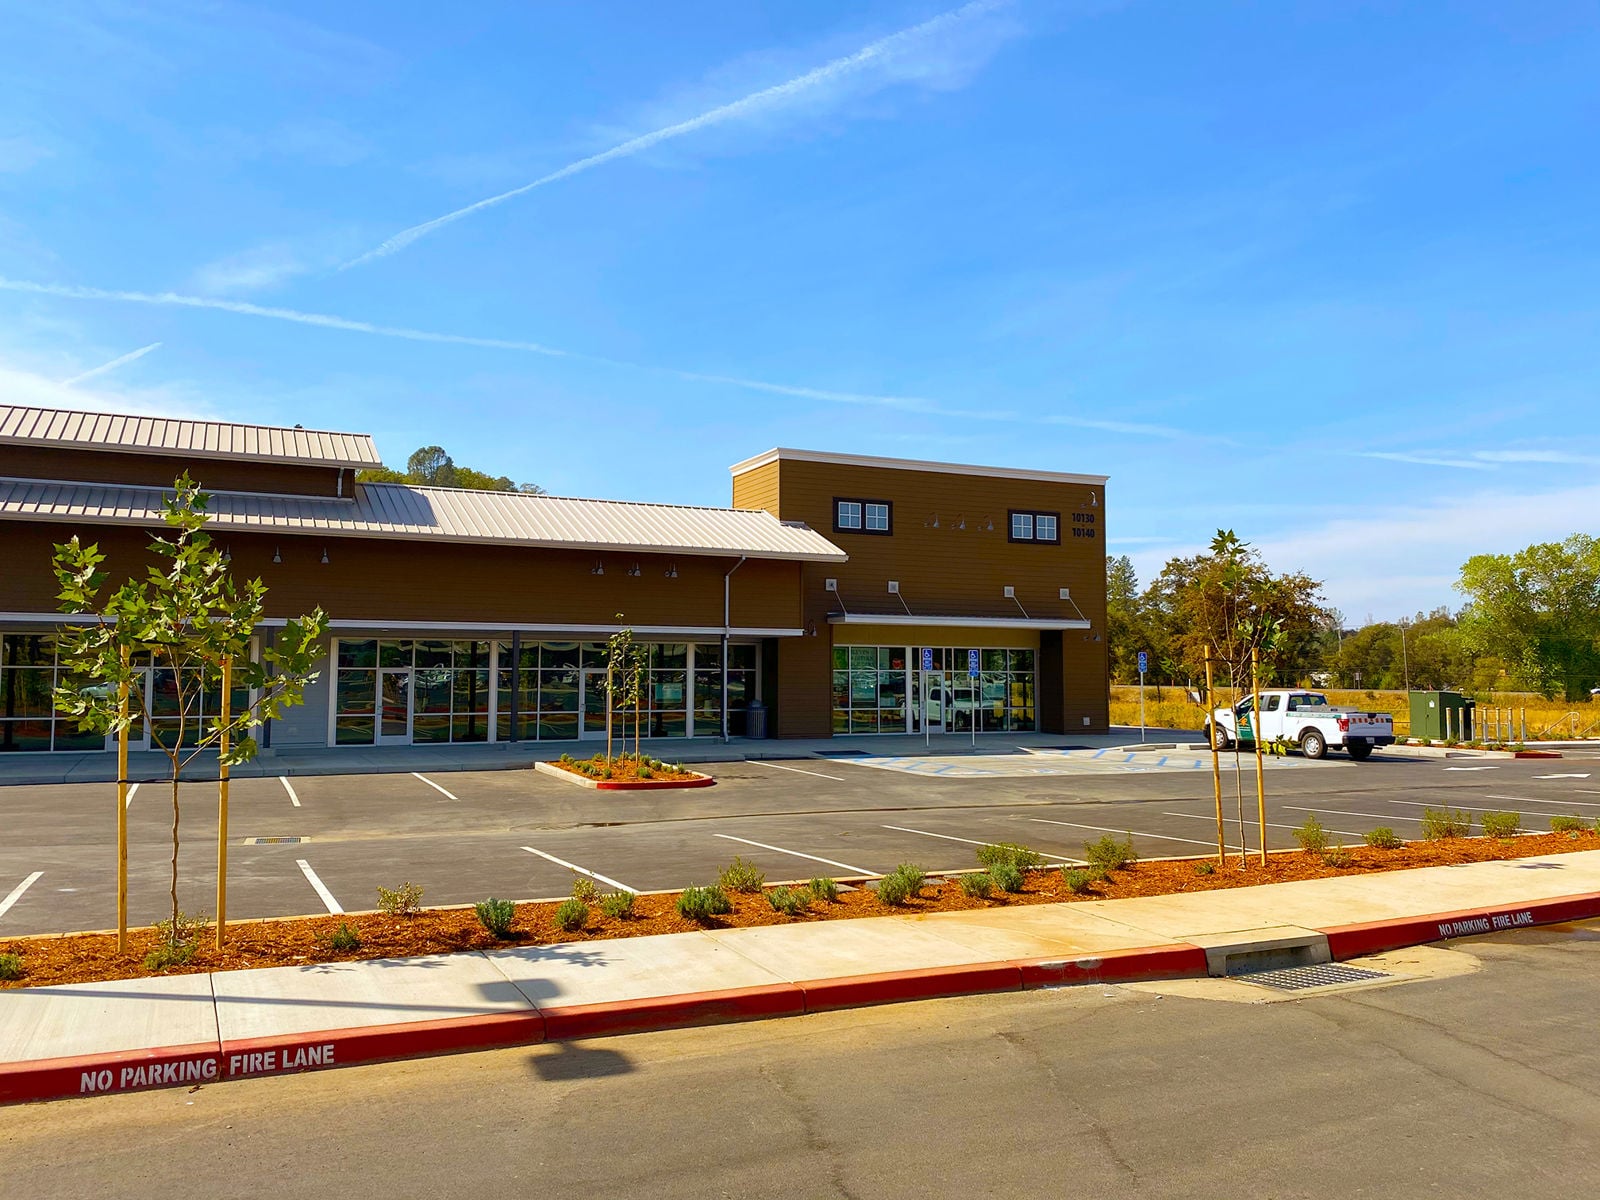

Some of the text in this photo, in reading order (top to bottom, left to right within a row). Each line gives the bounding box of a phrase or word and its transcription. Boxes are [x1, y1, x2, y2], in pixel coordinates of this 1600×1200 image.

[1072, 512, 1095, 523] 10130
[1072, 527, 1095, 538] 10140
[1438, 911, 1534, 936] NO PARKING FIRE LANE
[79, 1044, 335, 1093] NO PARKING FIRE LANE
